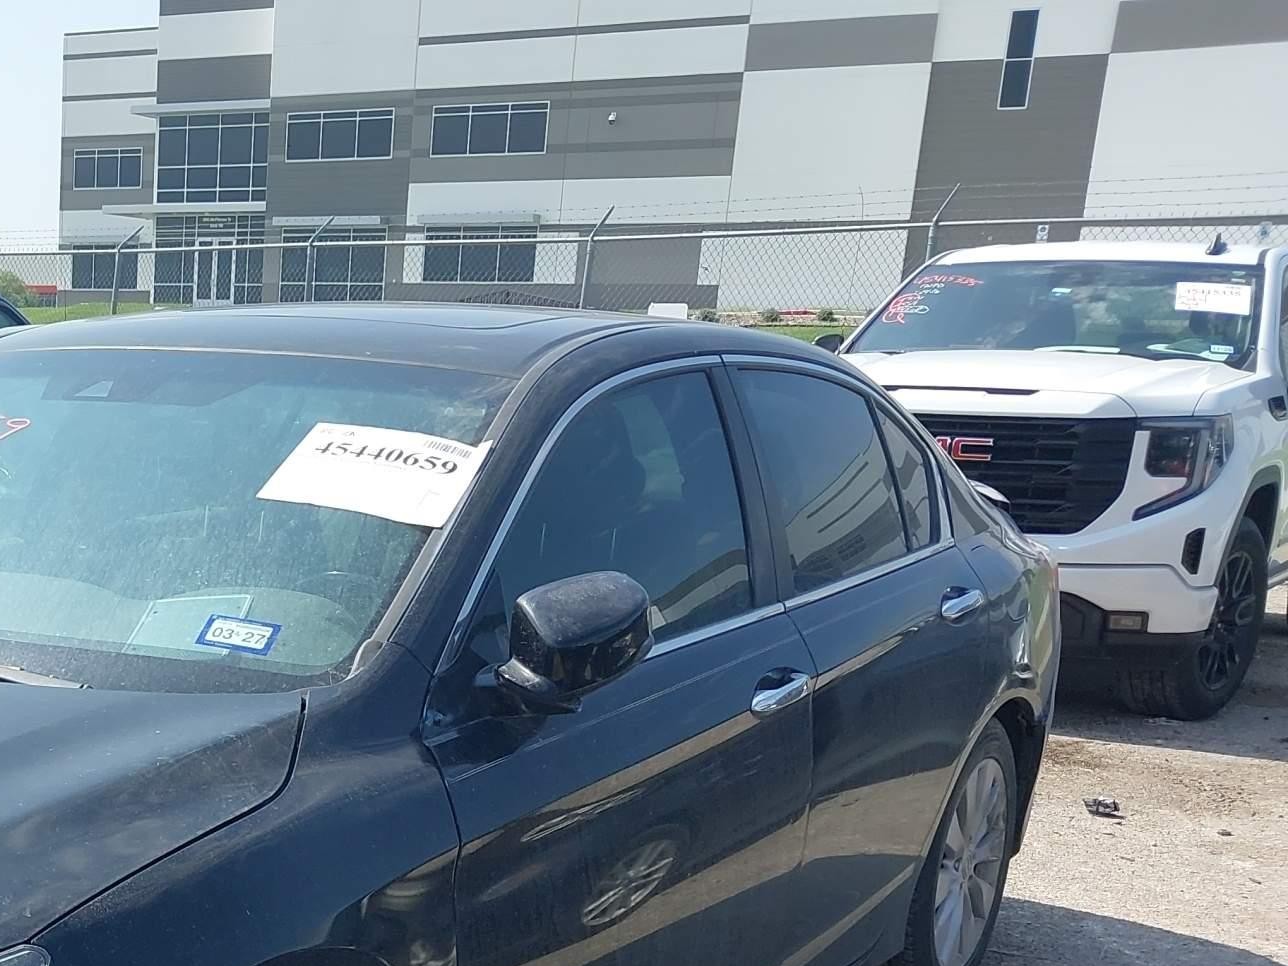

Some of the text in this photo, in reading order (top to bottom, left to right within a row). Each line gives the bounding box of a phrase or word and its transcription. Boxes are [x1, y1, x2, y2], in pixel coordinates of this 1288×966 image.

[314, 441, 459, 475] 45440659
[212, 627, 267, 645] 03 27
